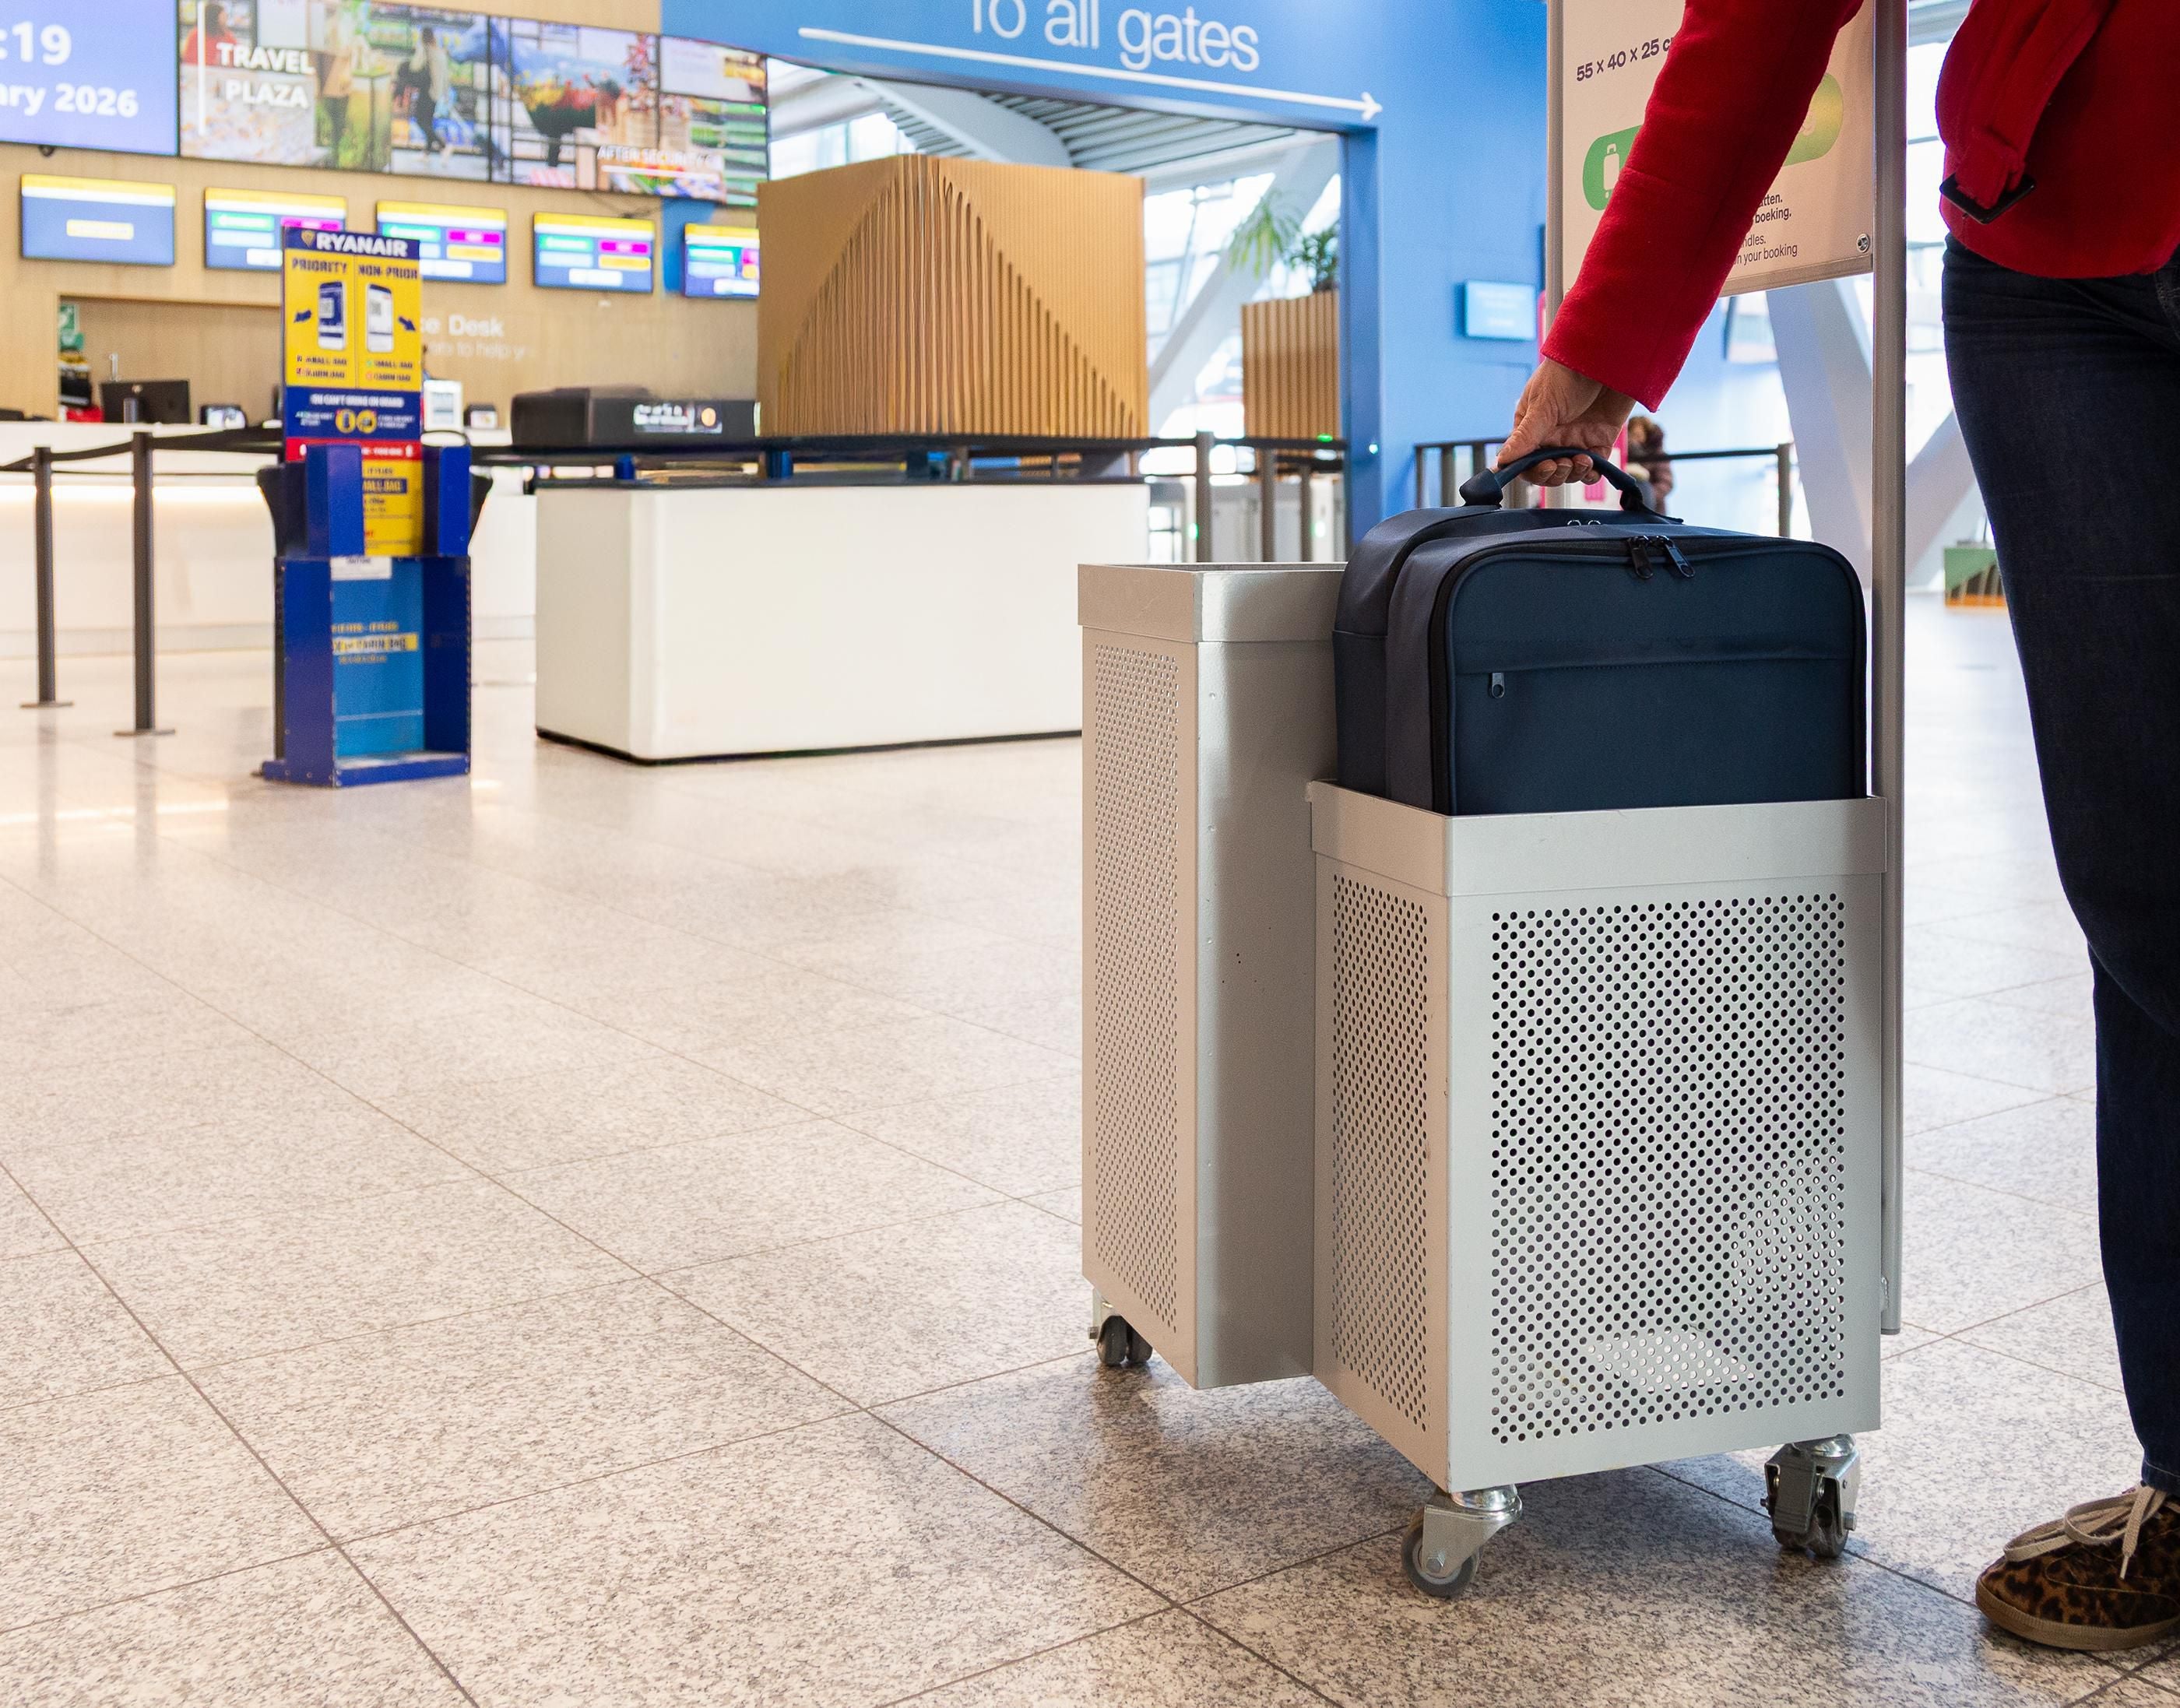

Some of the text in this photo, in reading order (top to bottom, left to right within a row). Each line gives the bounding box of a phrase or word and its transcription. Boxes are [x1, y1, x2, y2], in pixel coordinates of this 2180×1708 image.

[1044, 0, 1099, 50] all
[1118, 6, 1260, 72] gates
[216, 42, 316, 75] TRAVEL
[1577, 37, 1674, 82] 55 x 40 x 25 c
[54, 82, 139, 118] 2026
[226, 80, 308, 109] PLAZA
[1755, 208, 1791, 223] boeking.
[316, 232, 408, 258] RYANAIR
[1734, 244, 1798, 265] n your booking
[293, 258, 347, 274] PRIORITY
[448, 313, 505, 337] Desk
